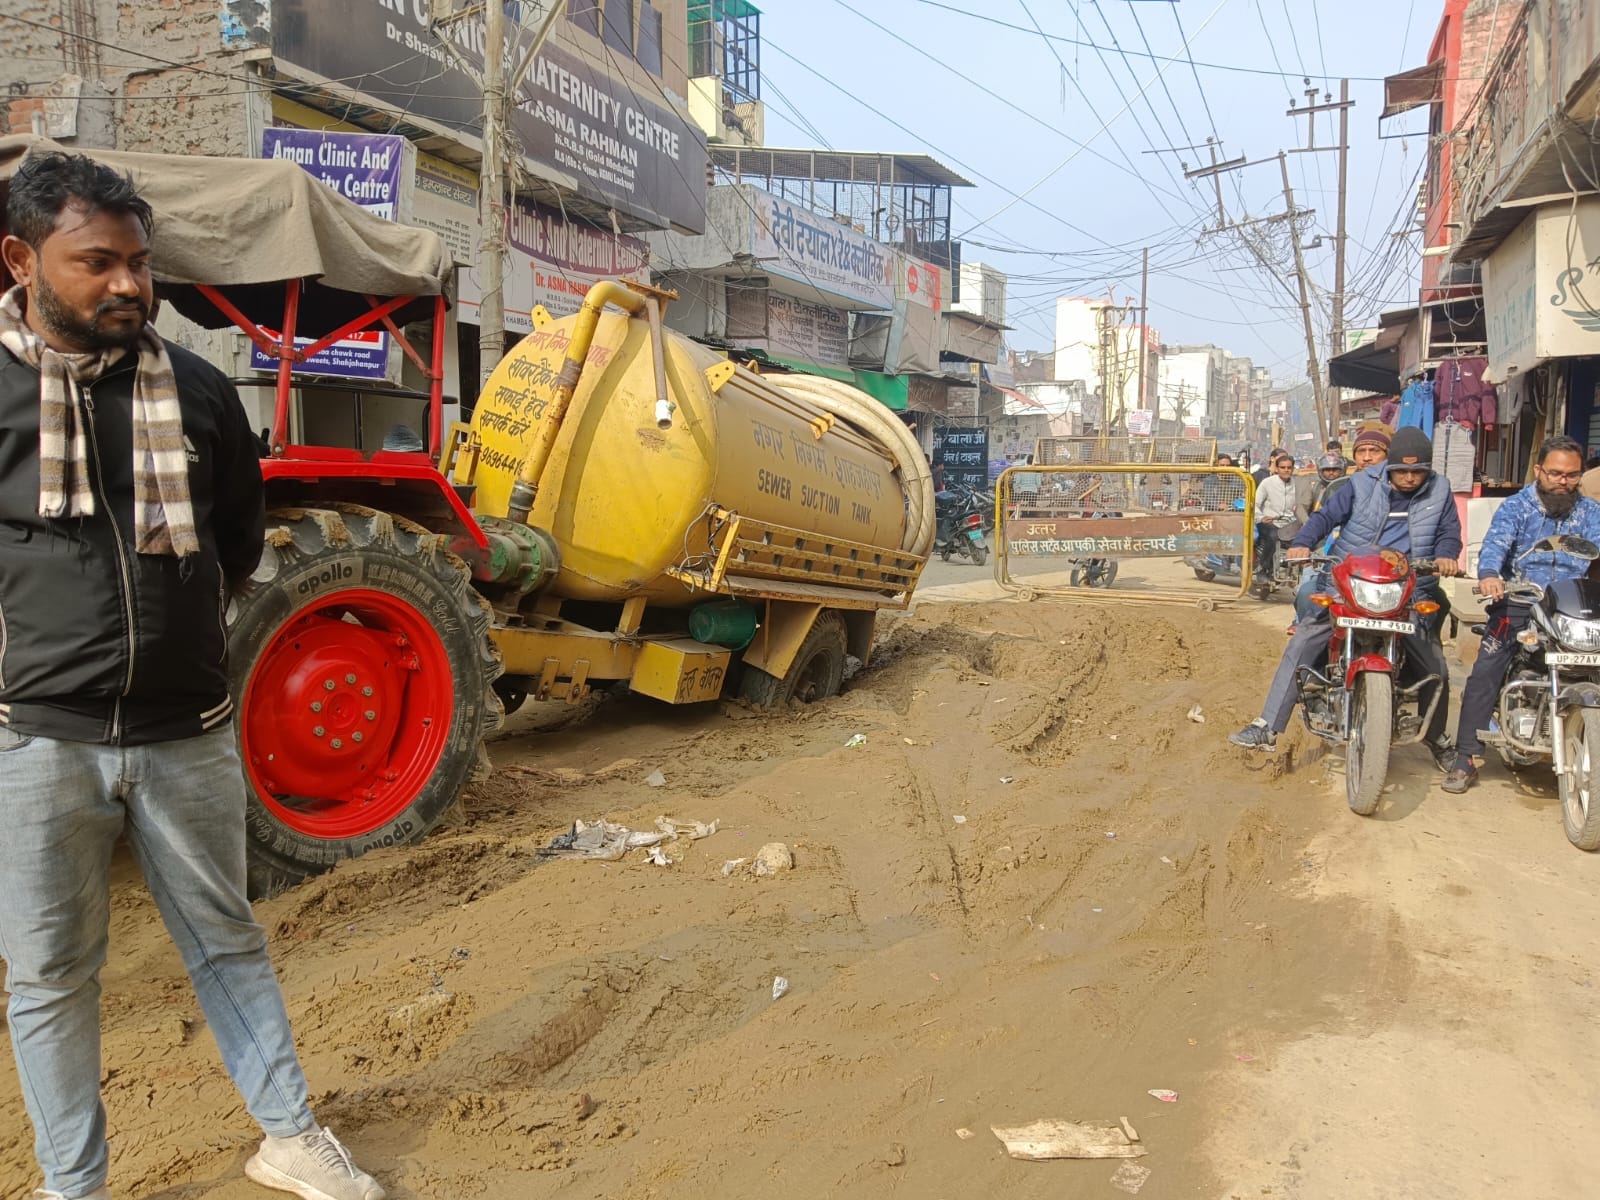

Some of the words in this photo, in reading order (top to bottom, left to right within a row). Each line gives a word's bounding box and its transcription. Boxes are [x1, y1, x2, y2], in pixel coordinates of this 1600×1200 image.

[580, 122, 638, 168] RAHMAN
[625, 106, 680, 160] CENTRE
[272, 140, 313, 165] Aman
[318, 142, 357, 168] Clinic
[360, 145, 390, 170] And
[344, 173, 390, 199] Centre
[511, 201, 544, 253] Clinic
[546, 215, 568, 261] And
[569, 222, 614, 275] Maternity
[772, 201, 796, 253] देवी
[795, 220, 831, 264] दयाल
[535, 271, 546, 288] Dr.
[547, 275, 567, 293] ASNA
[494, 385, 530, 415] सफाई
[758, 468, 792, 501] SEWER
[800, 484, 841, 516] SUCTION
[851, 502, 872, 525] TANK
[1179, 516, 1213, 532] प्रदेश
[1010, 538, 1038, 554] पुलिस
[1061, 537, 1095, 551] आपकी
[1099, 537, 1121, 552] सेवा
[297, 562, 353, 595] apollo
[367, 563, 435, 605] KRISHAK
[1556, 655, 1569, 663] UP
